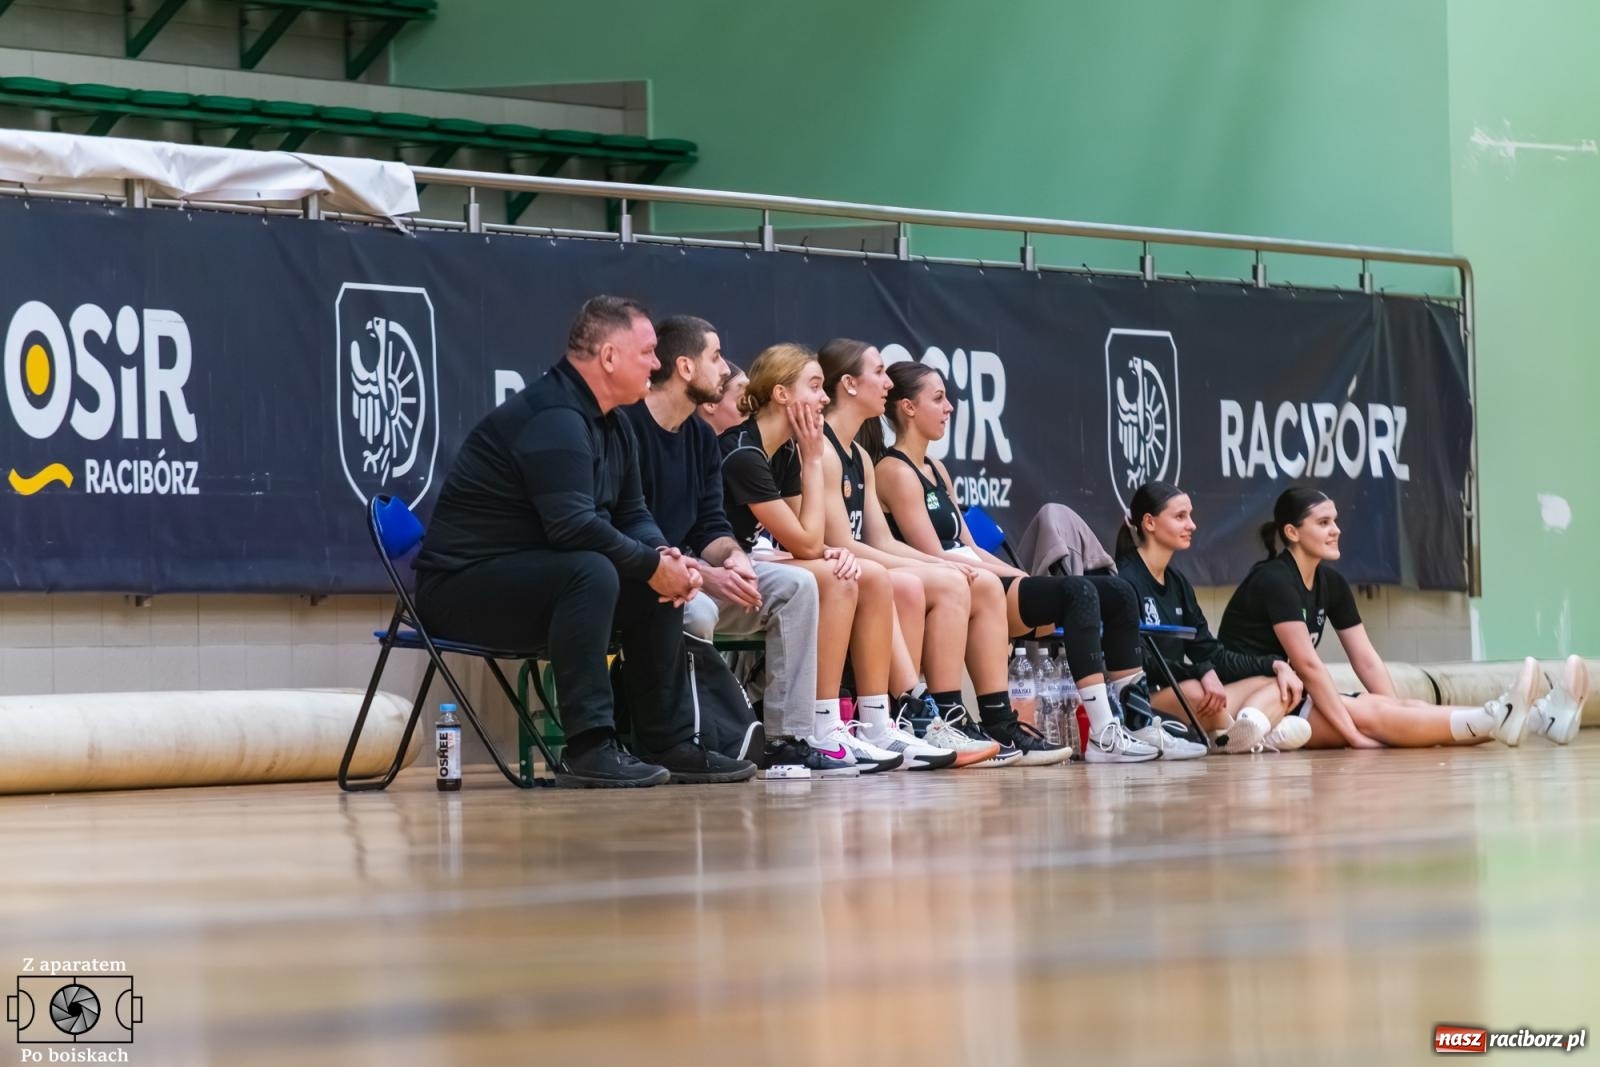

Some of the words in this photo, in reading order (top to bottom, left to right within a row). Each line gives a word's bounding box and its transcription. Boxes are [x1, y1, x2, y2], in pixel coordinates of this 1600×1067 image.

[1220, 376, 1410, 481] RACIBÓRZ
[85, 449, 200, 495] RACIBÓRZ
[439, 732, 449, 777] OSHEE
